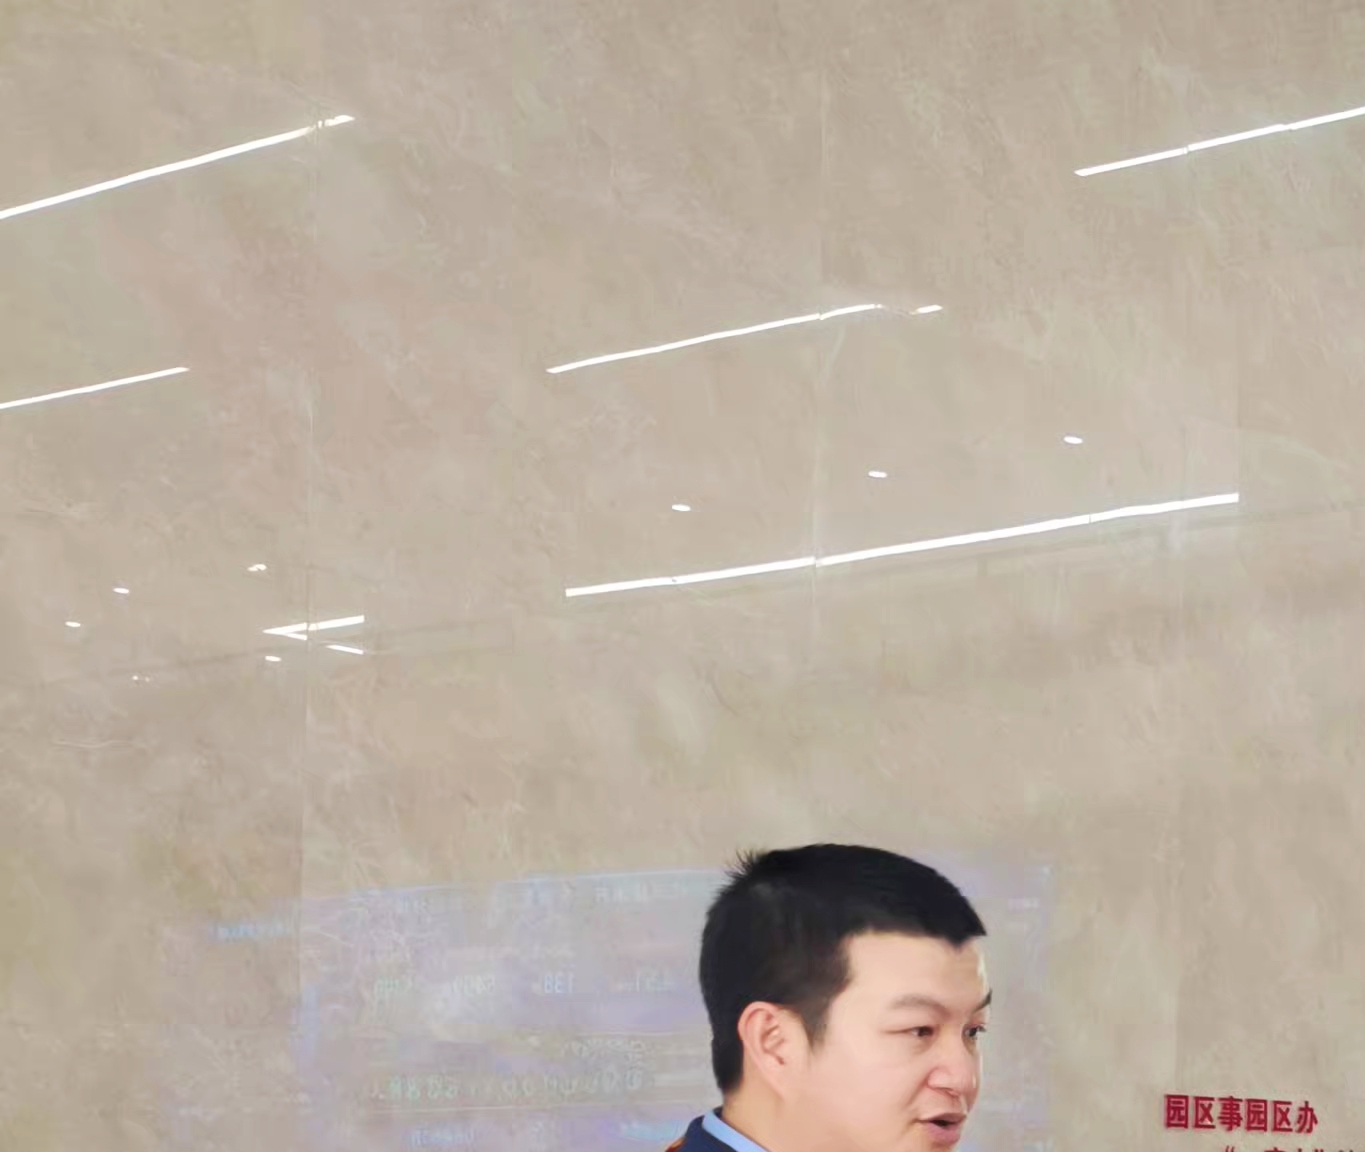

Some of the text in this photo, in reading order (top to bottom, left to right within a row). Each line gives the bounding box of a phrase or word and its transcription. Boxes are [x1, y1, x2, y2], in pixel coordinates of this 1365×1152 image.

[1164, 1094, 1318, 1133] 园区事园区办
